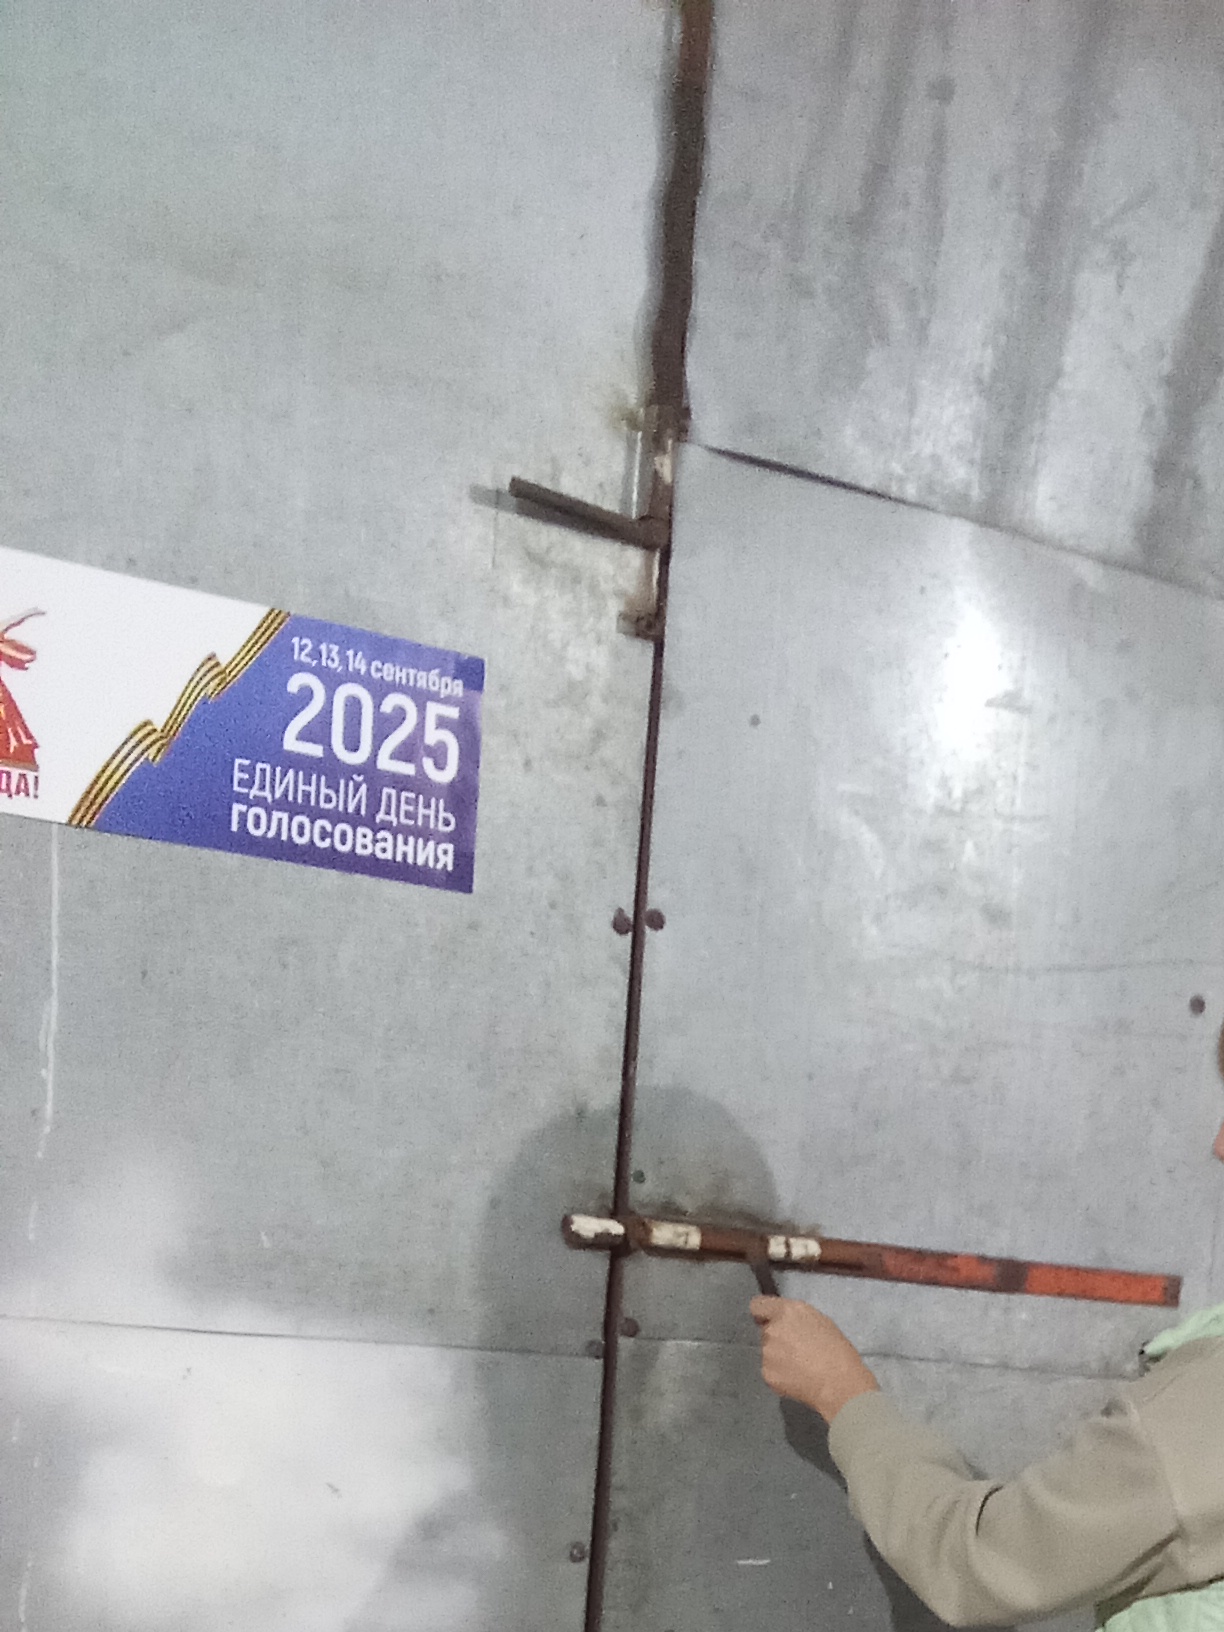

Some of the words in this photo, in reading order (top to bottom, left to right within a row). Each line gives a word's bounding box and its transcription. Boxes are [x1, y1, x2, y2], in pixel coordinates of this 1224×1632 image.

[370, 659, 464, 698] сентября
[282, 671, 461, 785] 2025
[232, 758, 368, 818] ЕДИНЫЙ
[375, 786, 456, 833] ДЕНЬ
[231, 802, 455, 872] голосования
